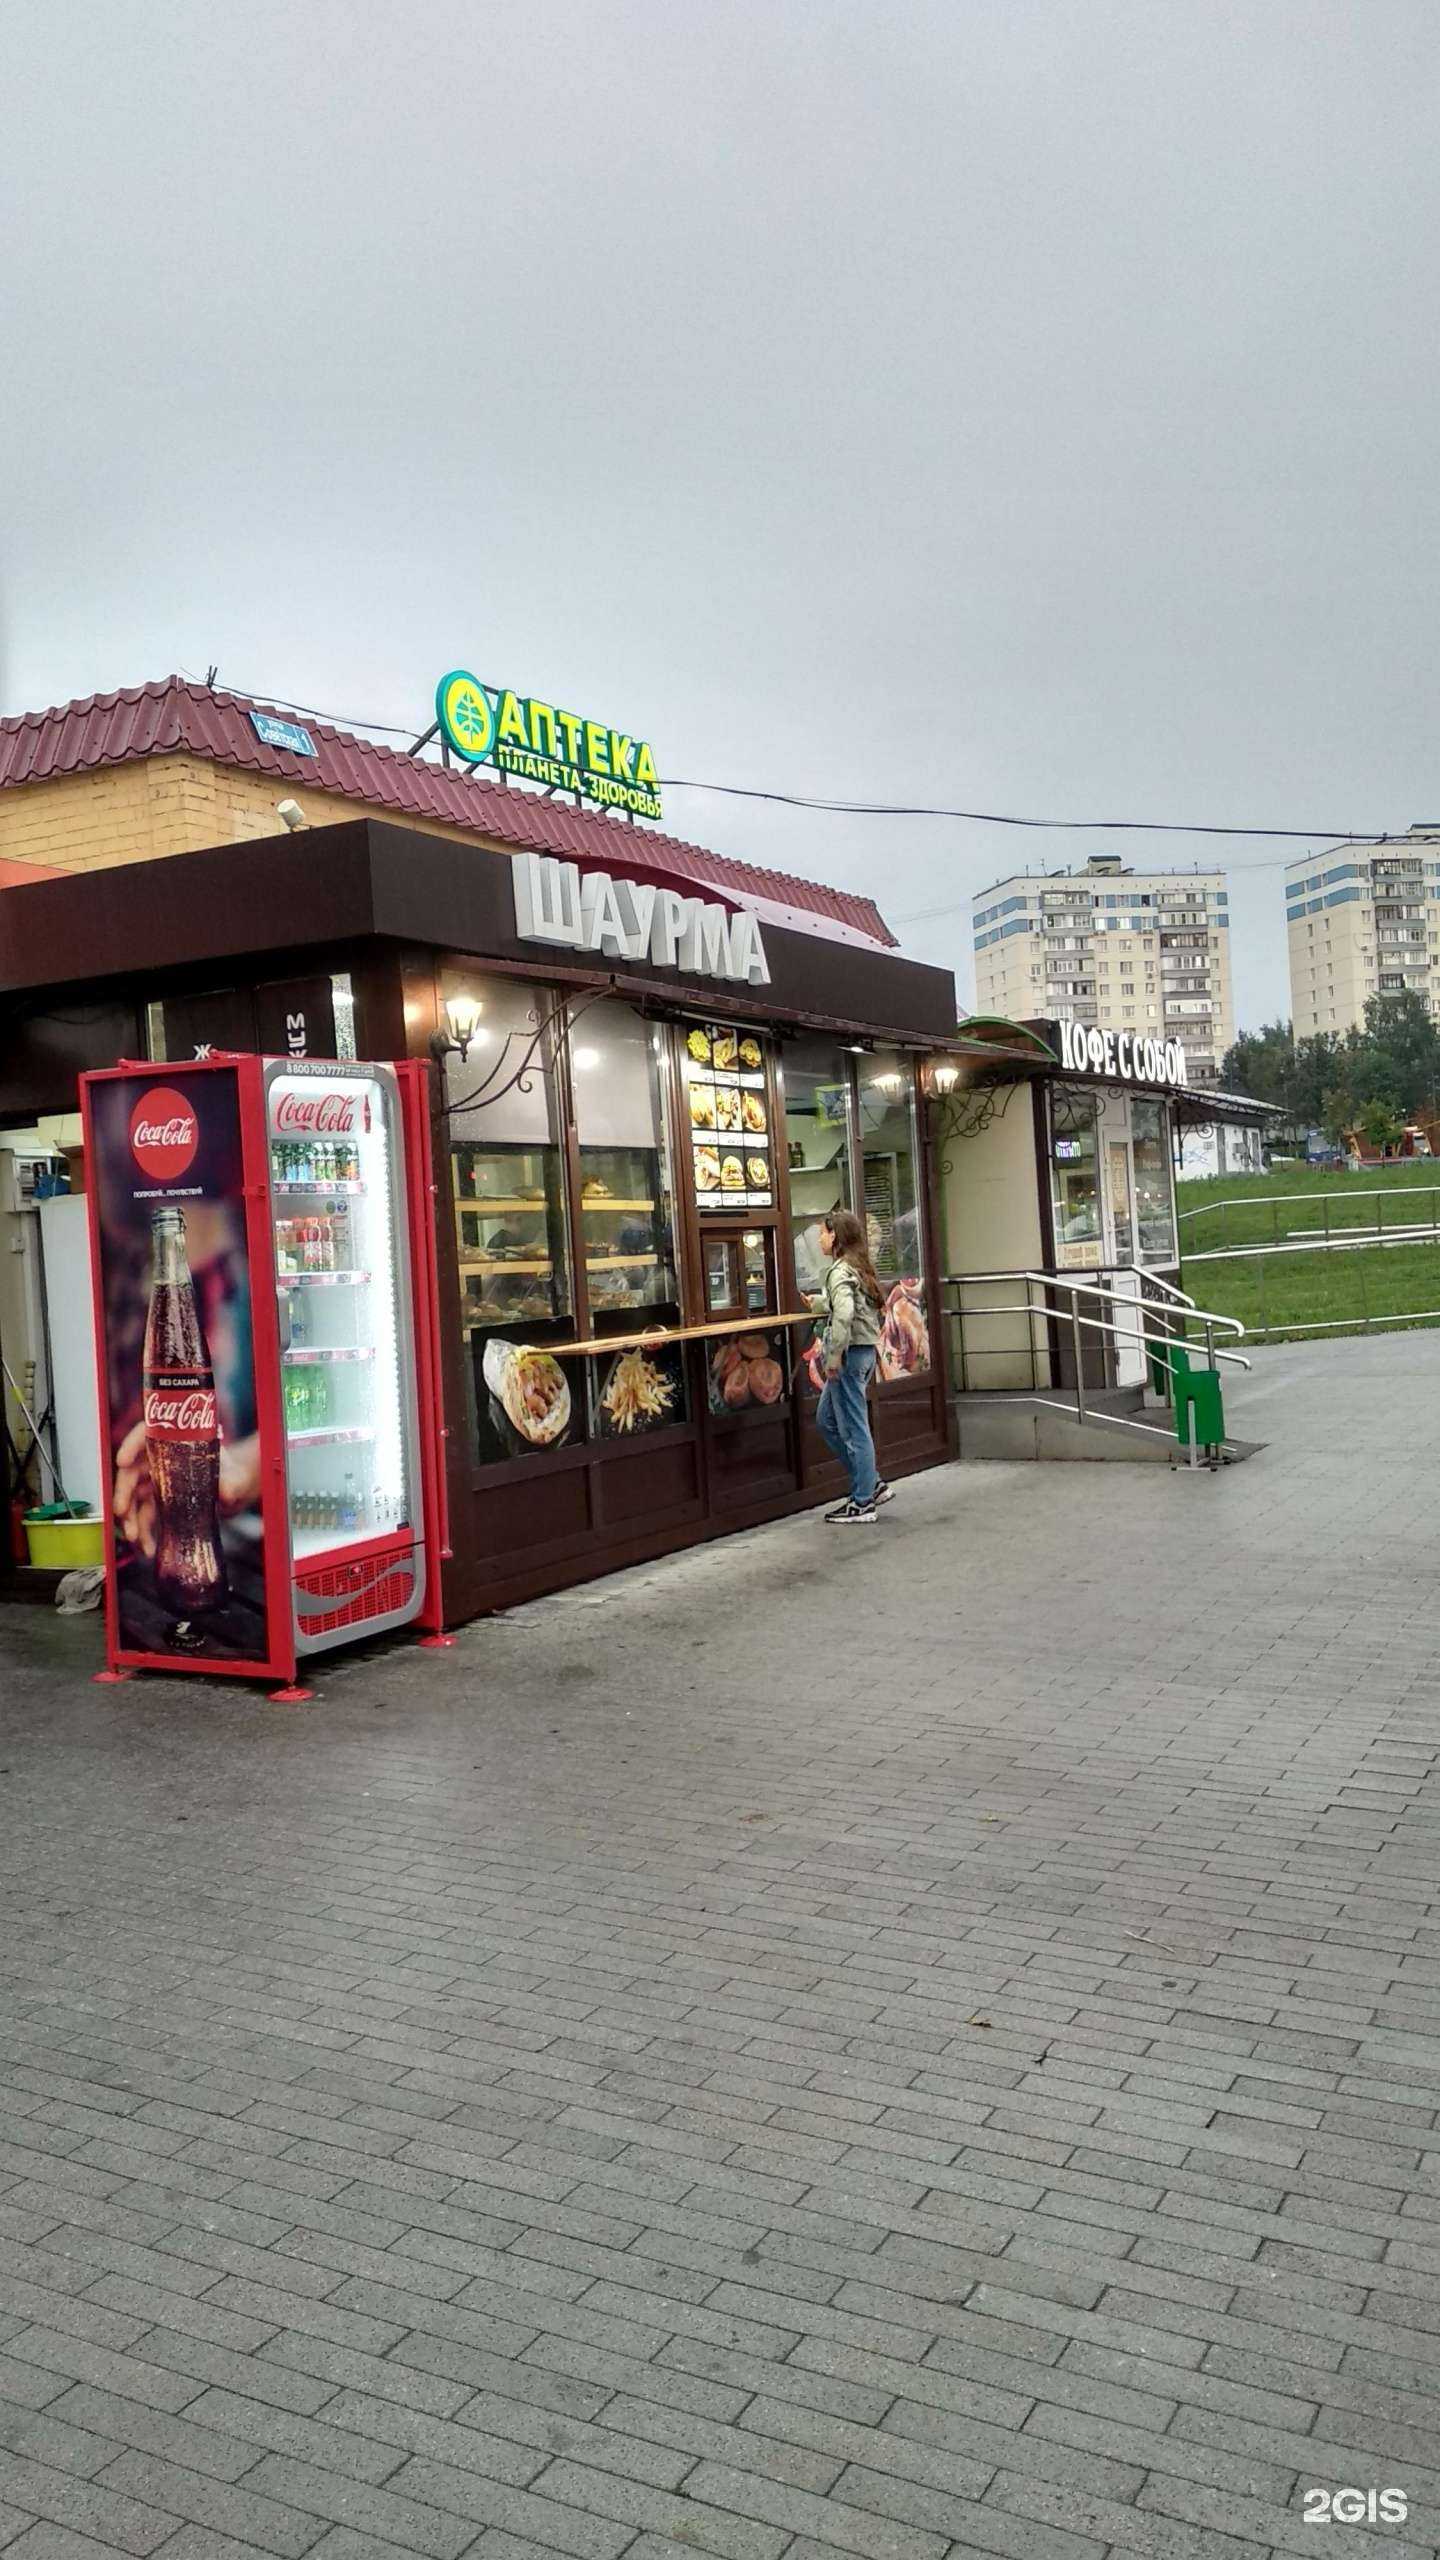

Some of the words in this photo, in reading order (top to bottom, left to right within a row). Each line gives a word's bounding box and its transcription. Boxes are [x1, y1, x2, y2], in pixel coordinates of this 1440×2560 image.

[498, 690, 661, 793] АПТЕКА
[499, 748, 582, 791] ПЛАНЕТА
[589, 775, 663, 818] ЗДОРОВЬЯ
[511, 852, 772, 986] ШАУРМА
[286, 1063, 293, 1074] 8
[293, 1064, 310, 1075] 800
[310, 1064, 326, 1075] 700
[1060, 1020, 1117, 1076] КОФЕ
[1118, 1033, 1132, 1079] С
[1132, 1036, 1188, 1086] СОБОЙ
[159, 1378, 172, 1387] БЕЗ
[172, 1378, 200, 1387] САХАРА
